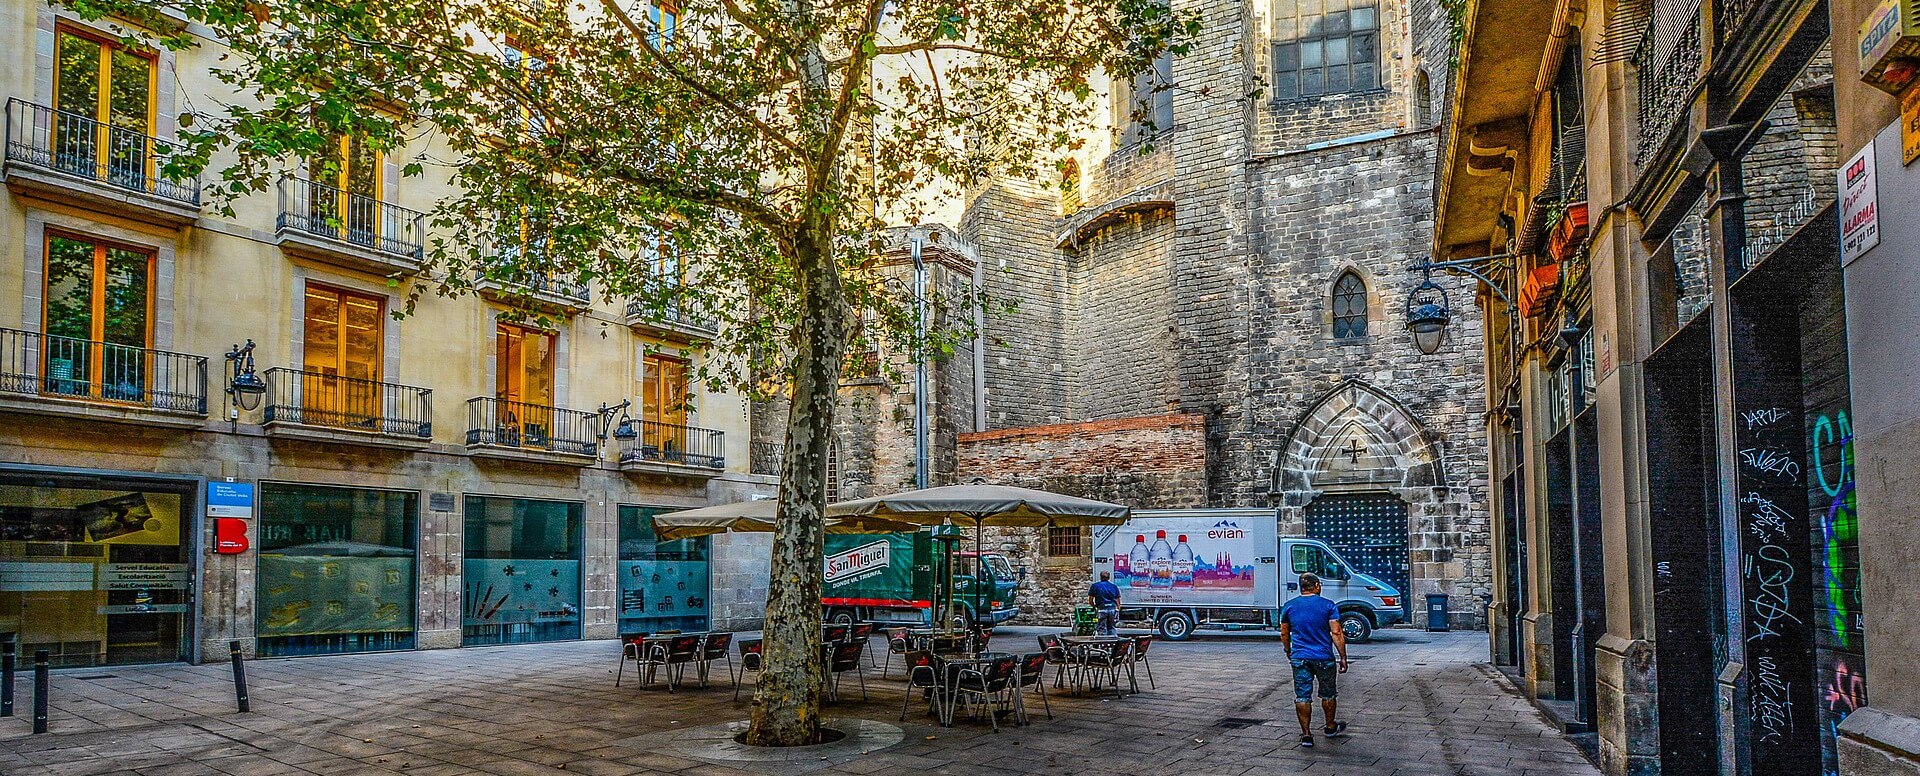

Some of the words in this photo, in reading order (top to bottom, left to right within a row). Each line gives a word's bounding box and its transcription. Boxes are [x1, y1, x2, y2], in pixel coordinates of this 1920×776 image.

[1862, 6, 1897, 55] SPITZ
[1843, 202, 1875, 236] ALARMA
[1741, 229, 1771, 269] tapes
[1207, 528, 1244, 539] evian
[825, 560, 849, 578] San
[848, 546, 885, 569] Miguel
